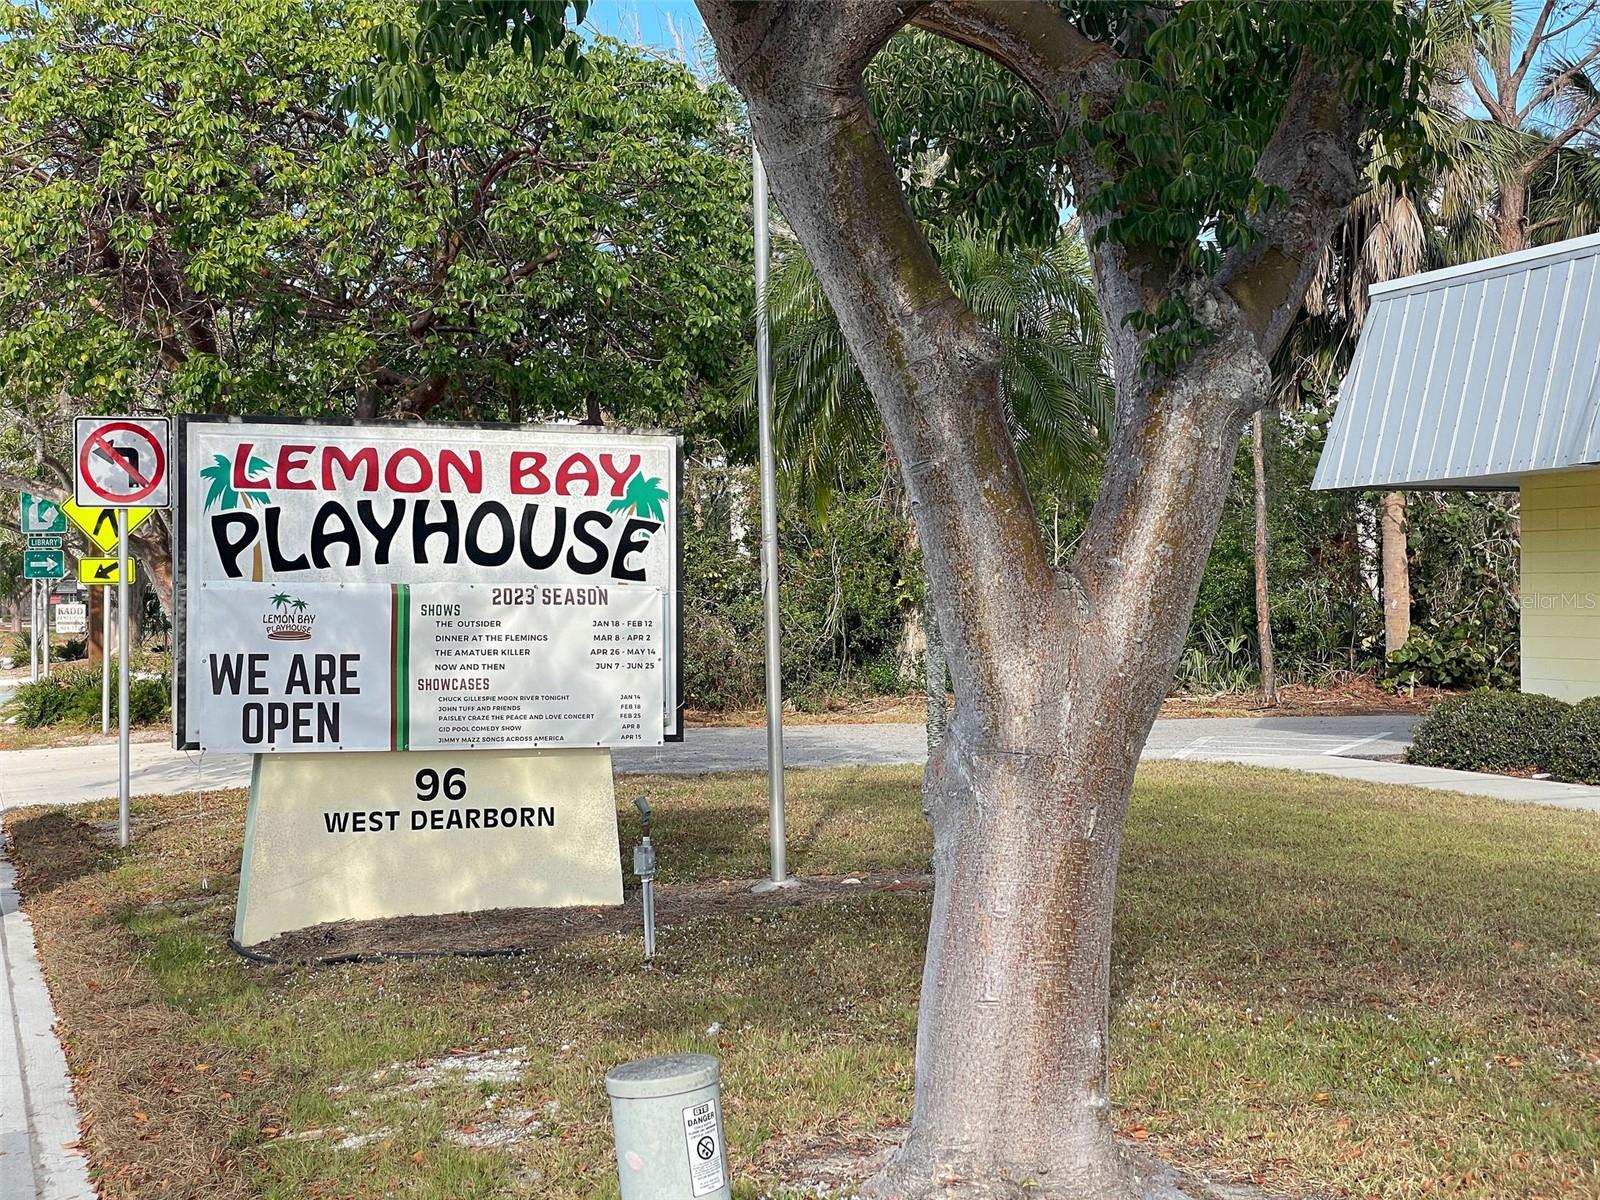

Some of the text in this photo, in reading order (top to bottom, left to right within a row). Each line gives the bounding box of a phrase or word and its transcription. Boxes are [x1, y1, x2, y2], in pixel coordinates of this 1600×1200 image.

[233, 443, 641, 497] LEMON BAY
[211, 499, 662, 581] PLAYHOUSE
[492, 588, 608, 606] 2023 SEASON
[421, 604, 461, 616] SHOWS
[262, 614, 316, 624] LEMON BAY
[435, 620, 502, 628] THE OUTSIDER
[266, 624, 312, 634] PLAYHOUSE
[505, 634, 548, 642] FLEMINGS
[209, 653, 361, 695] WE ARE
[418, 678, 490, 691] SHOWCASES
[242, 701, 340, 744] OPEN
[415, 767, 467, 801] 96
[324, 806, 555, 833] WEST DEARBORN
[687, 1111, 714, 1127] DANGER
